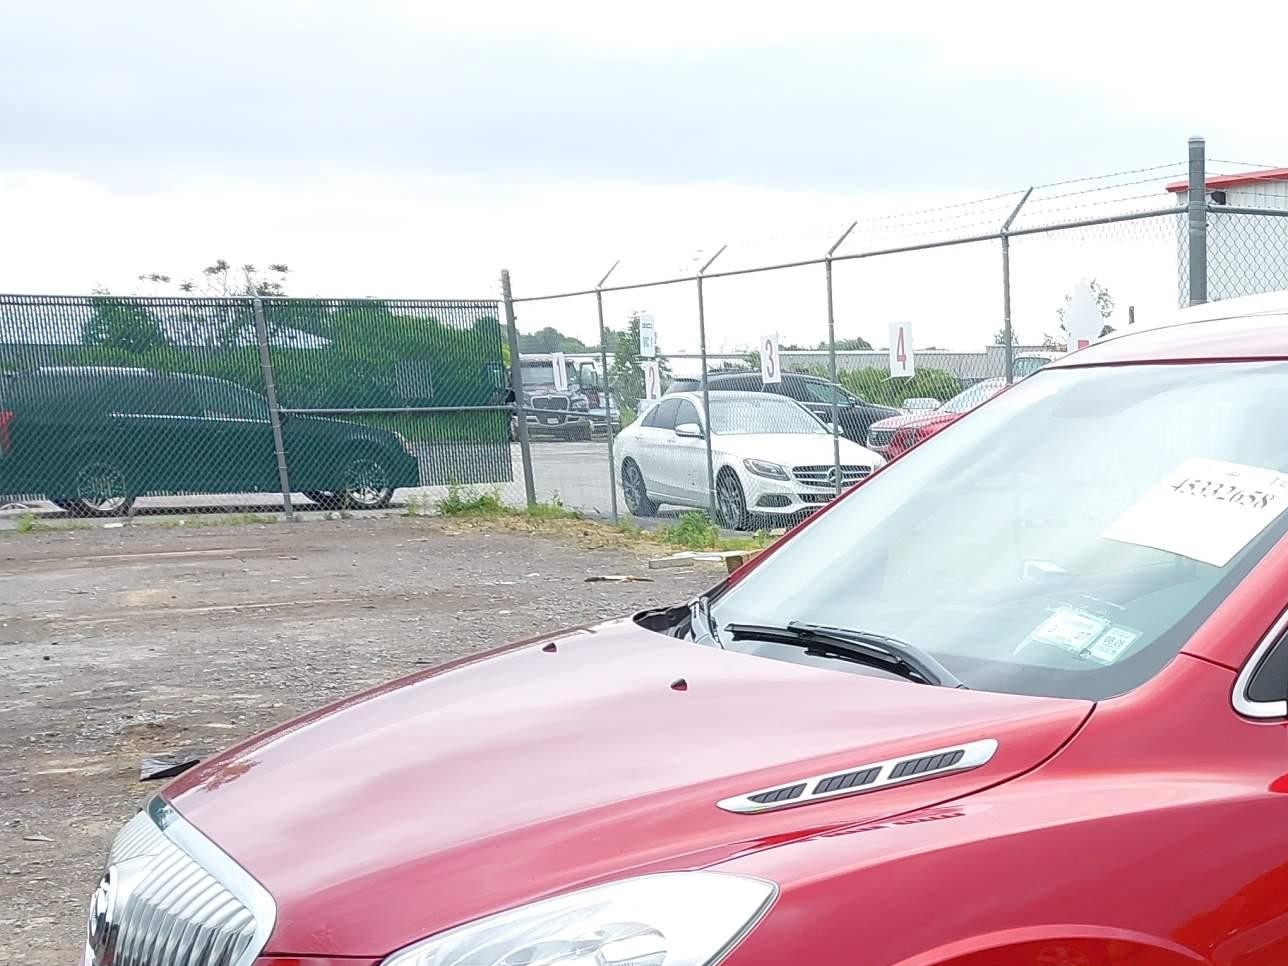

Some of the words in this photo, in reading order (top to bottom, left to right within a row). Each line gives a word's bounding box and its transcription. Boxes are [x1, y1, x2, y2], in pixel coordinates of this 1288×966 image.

[765, 338, 775, 378] 3
[896, 326, 907, 371] 4
[648, 366, 657, 400] 2
